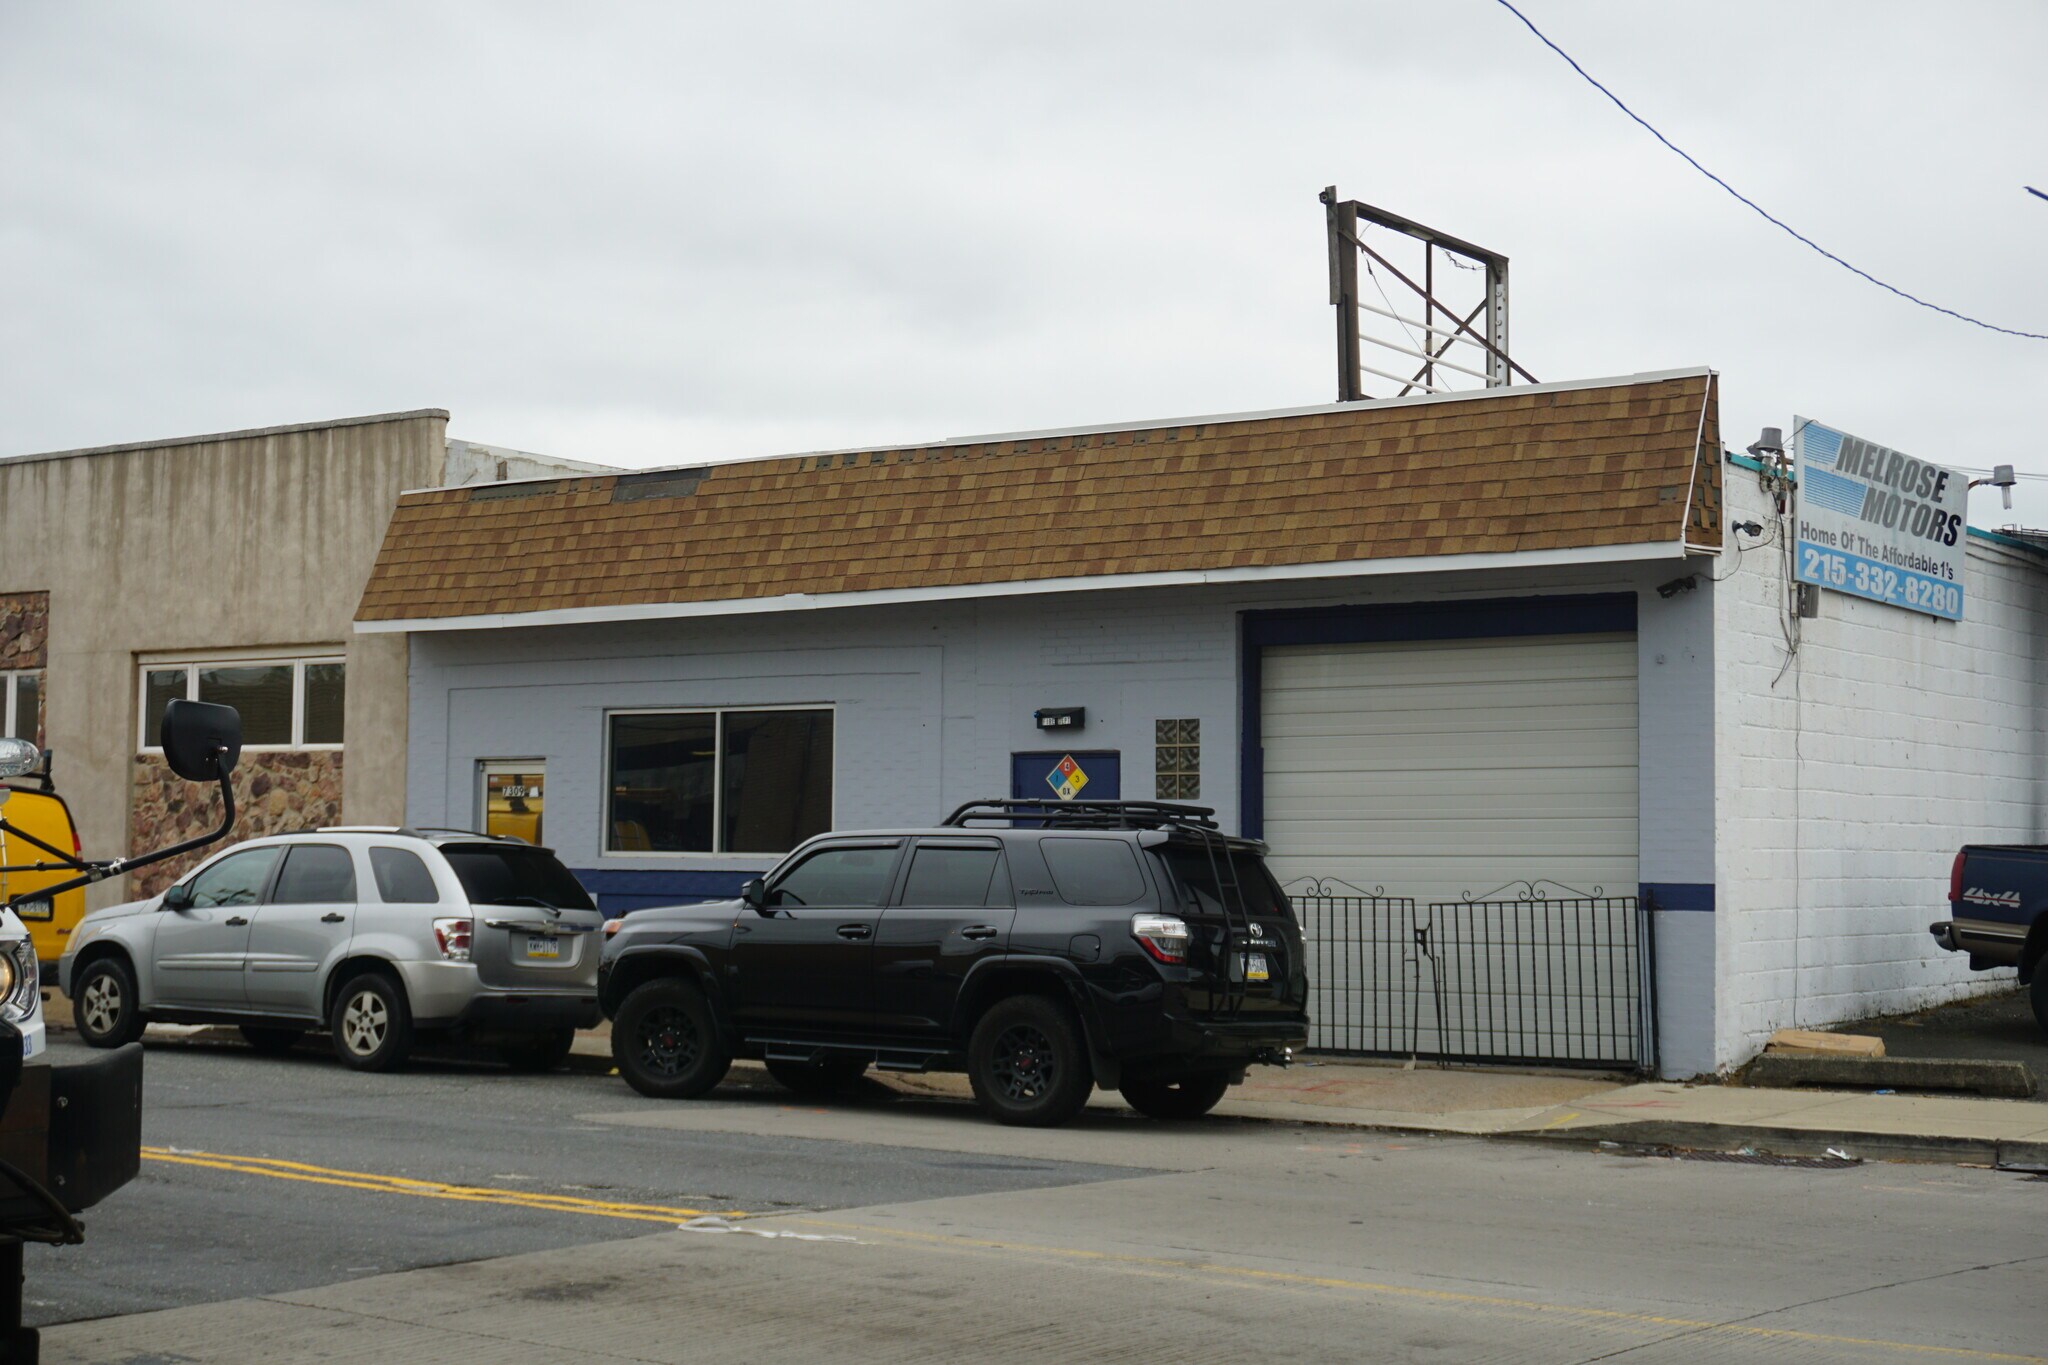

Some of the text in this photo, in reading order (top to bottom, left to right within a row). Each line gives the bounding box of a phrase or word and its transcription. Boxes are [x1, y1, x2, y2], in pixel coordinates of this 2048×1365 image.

[1835, 436, 1949, 503] MELROSE
[1860, 487, 1962, 546] MOTORS
[1801, 520, 1954, 580] Home Of The Affordable 1's
[1804, 548, 1958, 614] 215-332-8280
[503, 785, 524, 796] 7309
